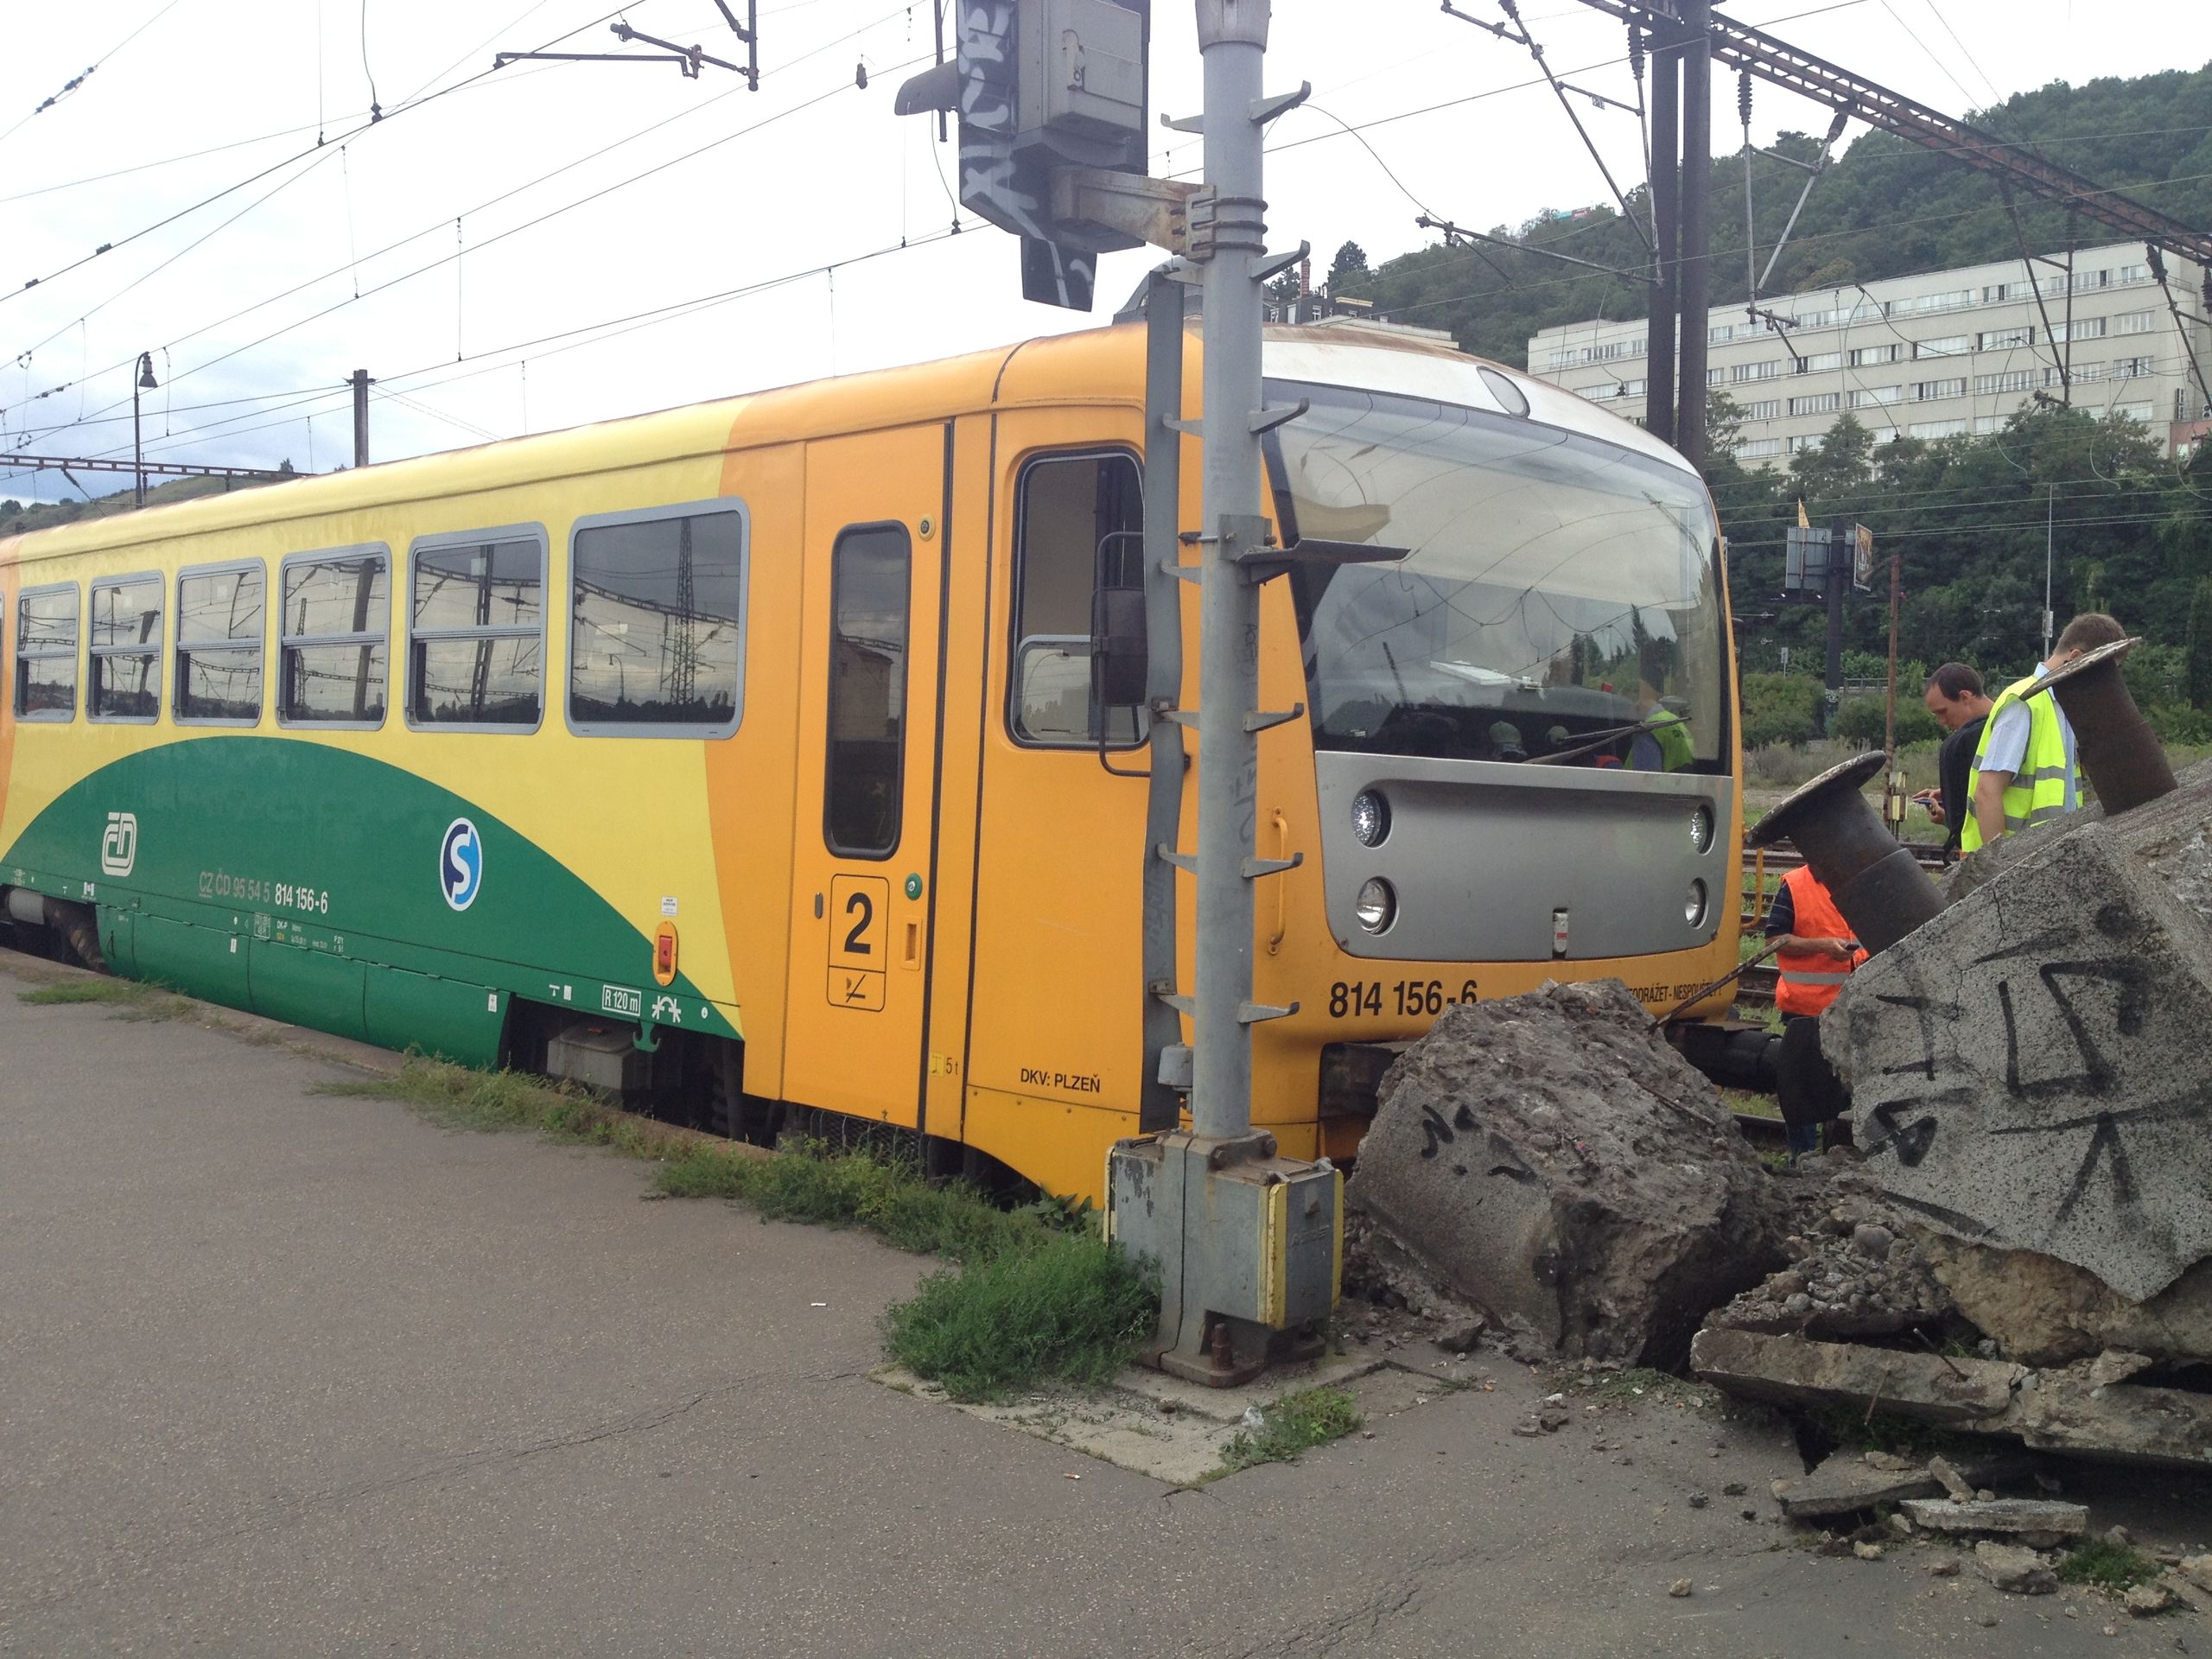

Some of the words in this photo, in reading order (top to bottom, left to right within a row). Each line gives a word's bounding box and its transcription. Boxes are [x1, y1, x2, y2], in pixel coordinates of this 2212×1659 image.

[443, 821, 480, 907] S
[200, 871, 213, 894] CZ
[215, 868, 231, 895] ČD
[233, 877, 245, 899] 95
[248, 880, 260, 900] 54
[264, 882, 270, 903] 5
[275, 883, 293, 906] 814
[296, 887, 327, 914] 156-6
[844, 892, 873, 955] 2
[605, 994, 612, 1007] R
[613, 991, 627, 1010] 120
[630, 998, 639, 1012] m
[1329, 982, 1382, 1018] 814
[1393, 980, 1478, 1016] 156-6
[946, 1058, 952, 1074] 5
[1020, 1068, 1051, 1086] DKV:
[1054, 1073, 1100, 1093] PLZEŇ
